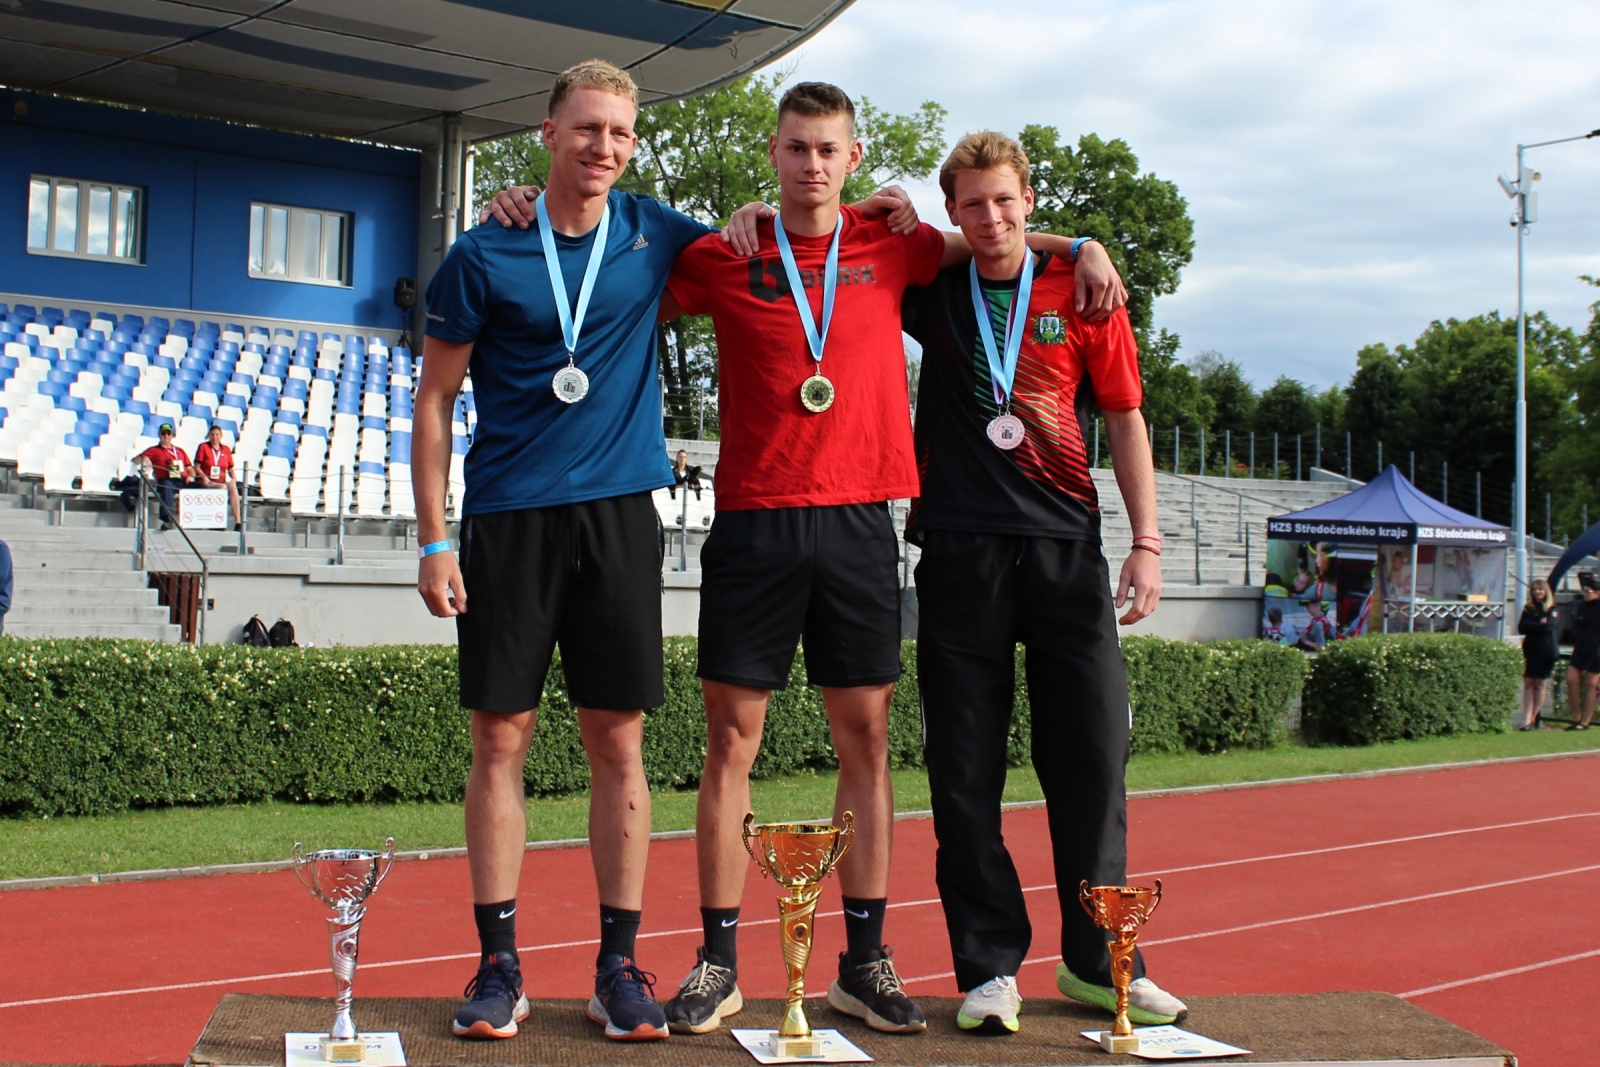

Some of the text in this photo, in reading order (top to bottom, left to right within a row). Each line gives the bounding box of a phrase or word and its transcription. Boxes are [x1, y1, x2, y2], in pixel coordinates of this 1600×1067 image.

[1269, 522, 1408, 539] HZS Středočeského kraje
[1417, 527, 1434, 538] HZS
[1488, 530, 1507, 543] kraje
